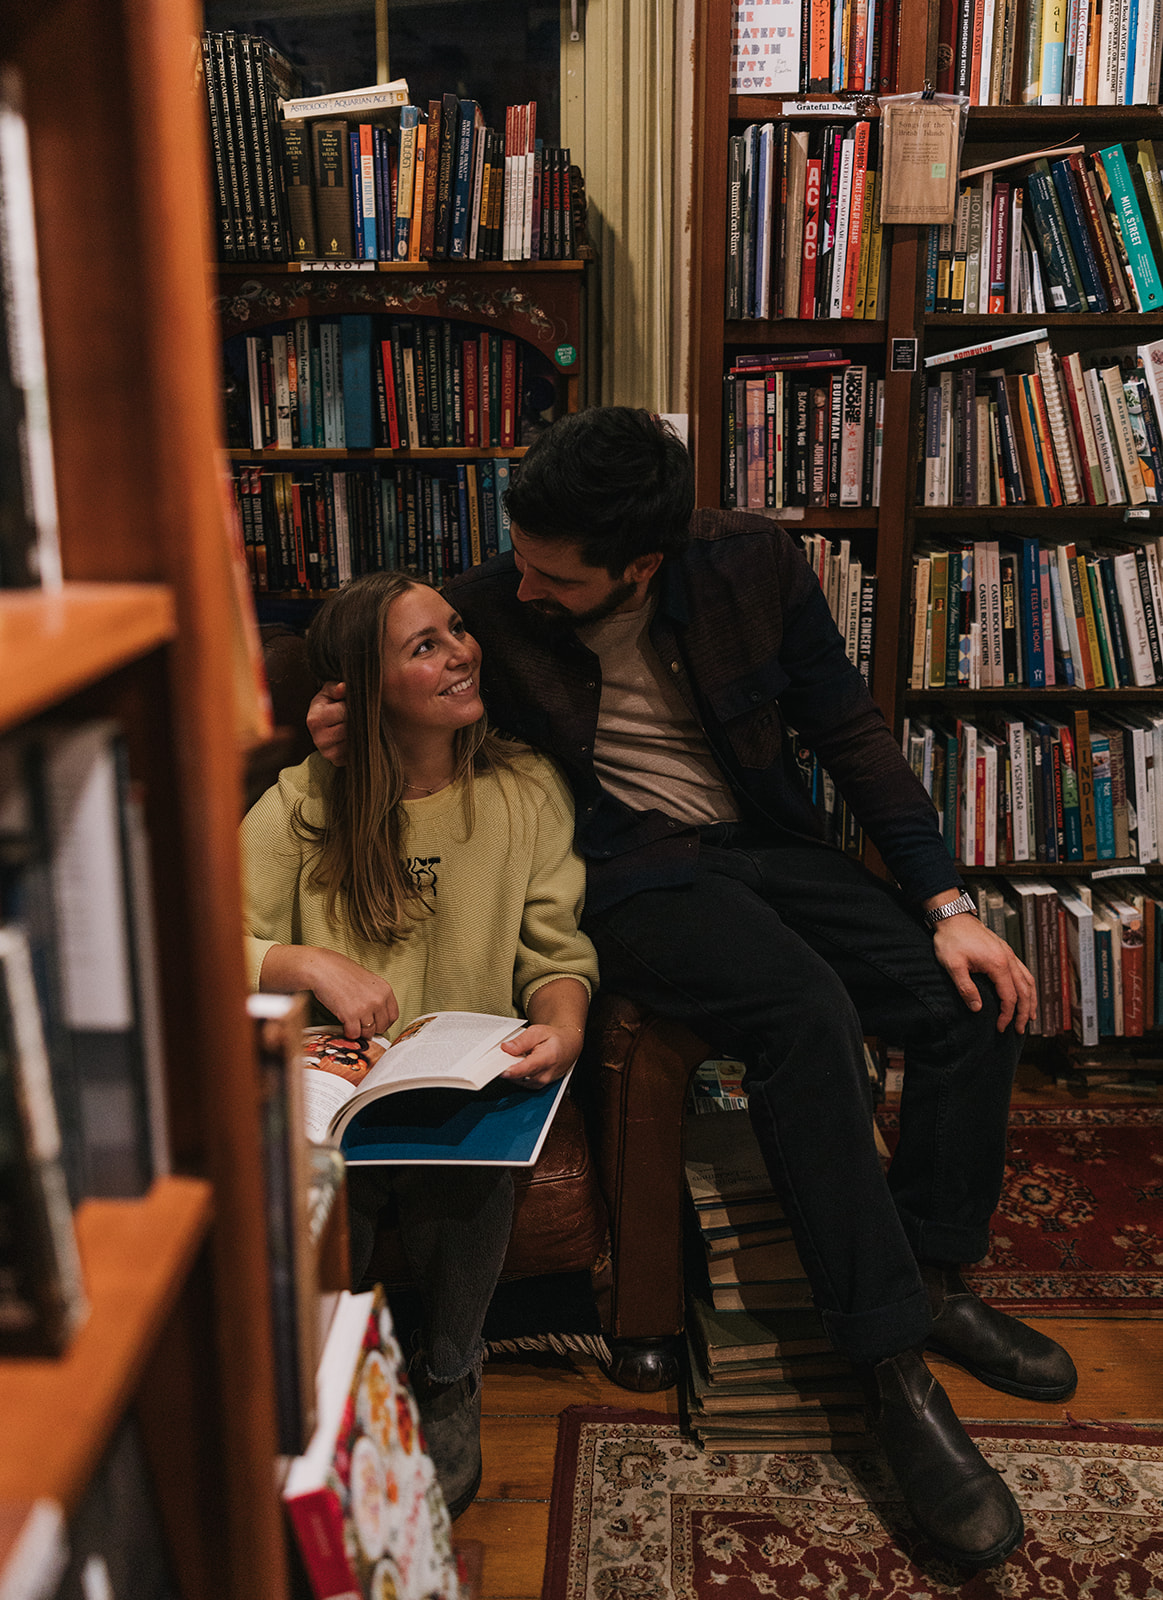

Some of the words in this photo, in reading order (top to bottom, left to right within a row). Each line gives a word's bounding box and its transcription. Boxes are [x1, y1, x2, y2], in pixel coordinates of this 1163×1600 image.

[732, 12, 754, 22] HE
[1079, 8, 1087, 22] Ice
[730, 27, 795, 39] RATEFUL
[961, 19, 969, 58] INDIGENOUS
[1078, 24, 1087, 57] Cream
[732, 44, 760, 55] EAD
[764, 43, 781, 55] IN
[974, 35, 982, 56] TASTE
[1120, 32, 1128, 62] YOGURT
[730, 61, 767, 72] IFTY
[731, 77, 773, 88] HOWS
[290, 101, 329, 113] ASTROLOGY
[334, 96, 372, 107] AQUARIAN
[373, 95, 387, 104] AGE
[797, 104, 830, 115] Grateful
[363, 157, 372, 179] TAROT
[854, 172, 864, 193] SECRET
[865, 180, 874, 200] Jerry
[364, 181, 374, 217] TRIUMPHS
[853, 194, 862, 211] SPACE
[864, 202, 873, 213] on
[960, 196, 969, 217] Kitchen
[998, 197, 1006, 211] Wine
[1120, 195, 1134, 216] MILK
[970, 195, 980, 229] HOME
[851, 220, 861, 244] DREAMS
[862, 215, 872, 234] Jerry
[1126, 218, 1142, 246] STREET
[730, 232, 740, 256] Rims
[997, 229, 1005, 248] Guide
[968, 234, 979, 267] MADE
[996, 254, 1004, 263] the
[307, 261, 364, 271] TAROT
[953, 344, 993, 361] KOMBUCHA
[417, 365, 425, 397] HEKATE
[430, 383, 438, 411] WILD
[504, 382, 512, 404] LOVE
[831, 383, 842, 440] BUNNYMAN
[1116, 397, 1127, 425] MAINE
[813, 443, 824, 465] JOHN
[1099, 442, 1112, 473] kitchen
[1121, 427, 1134, 466] CLASSICS
[812, 467, 824, 493] LYDON
[862, 587, 873, 613] ROCK
[979, 584, 987, 611] CASTLE
[991, 584, 999, 611] CASTLE
[1031, 588, 1039, 610] FEELS
[980, 612, 988, 633] ROCK
[992, 612, 1000, 633] ROCK
[1032, 611, 1040, 628] LIKE
[860, 617, 872, 655] CONCERT
[1033, 629, 1041, 653] HOME
[981, 634, 989, 666] KITCHEN
[993, 634, 1001, 666] KITCHEN
[1014, 730, 1022, 760] BAKING
[1015, 763, 1024, 811] YESTERYEAR
[1081, 751, 1094, 827] INDIA
